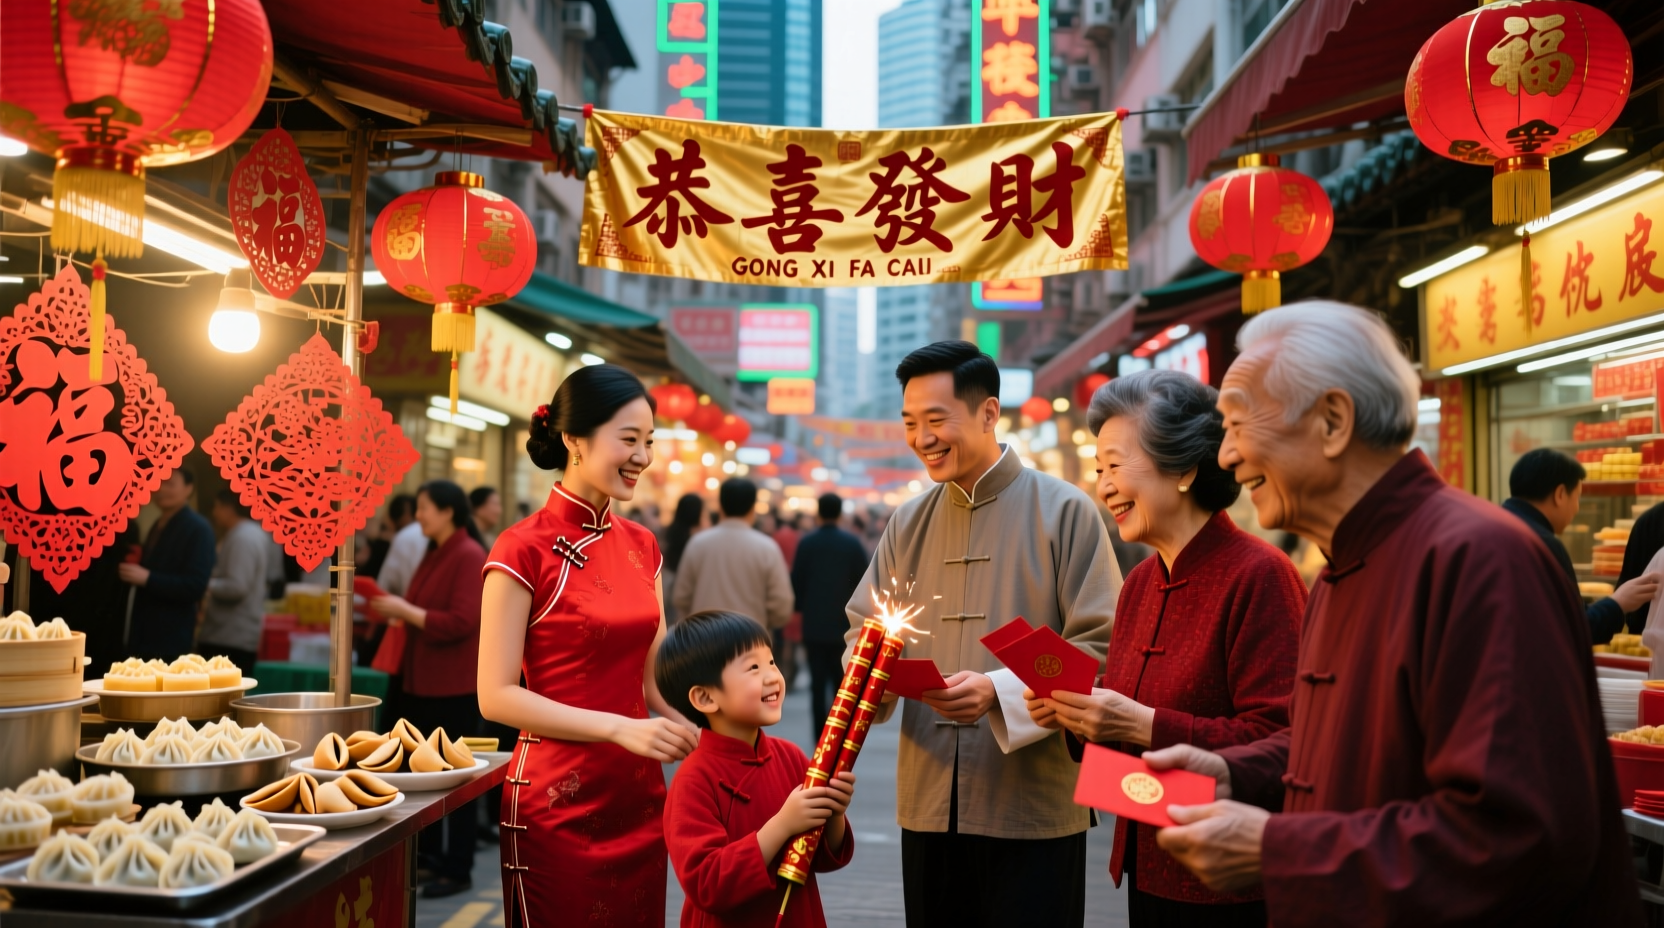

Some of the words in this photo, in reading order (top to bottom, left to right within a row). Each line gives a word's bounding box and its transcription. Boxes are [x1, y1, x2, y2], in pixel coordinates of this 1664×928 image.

[1486, 13, 1575, 97] 福
[252, 168, 306, 269] 福
[624, 138, 1087, 254] 恭喜發財
[731, 257, 798, 278] GONG
[811, 259, 834, 278] XI
[850, 259, 875, 278] FA
[0, 339, 134, 515] 福
